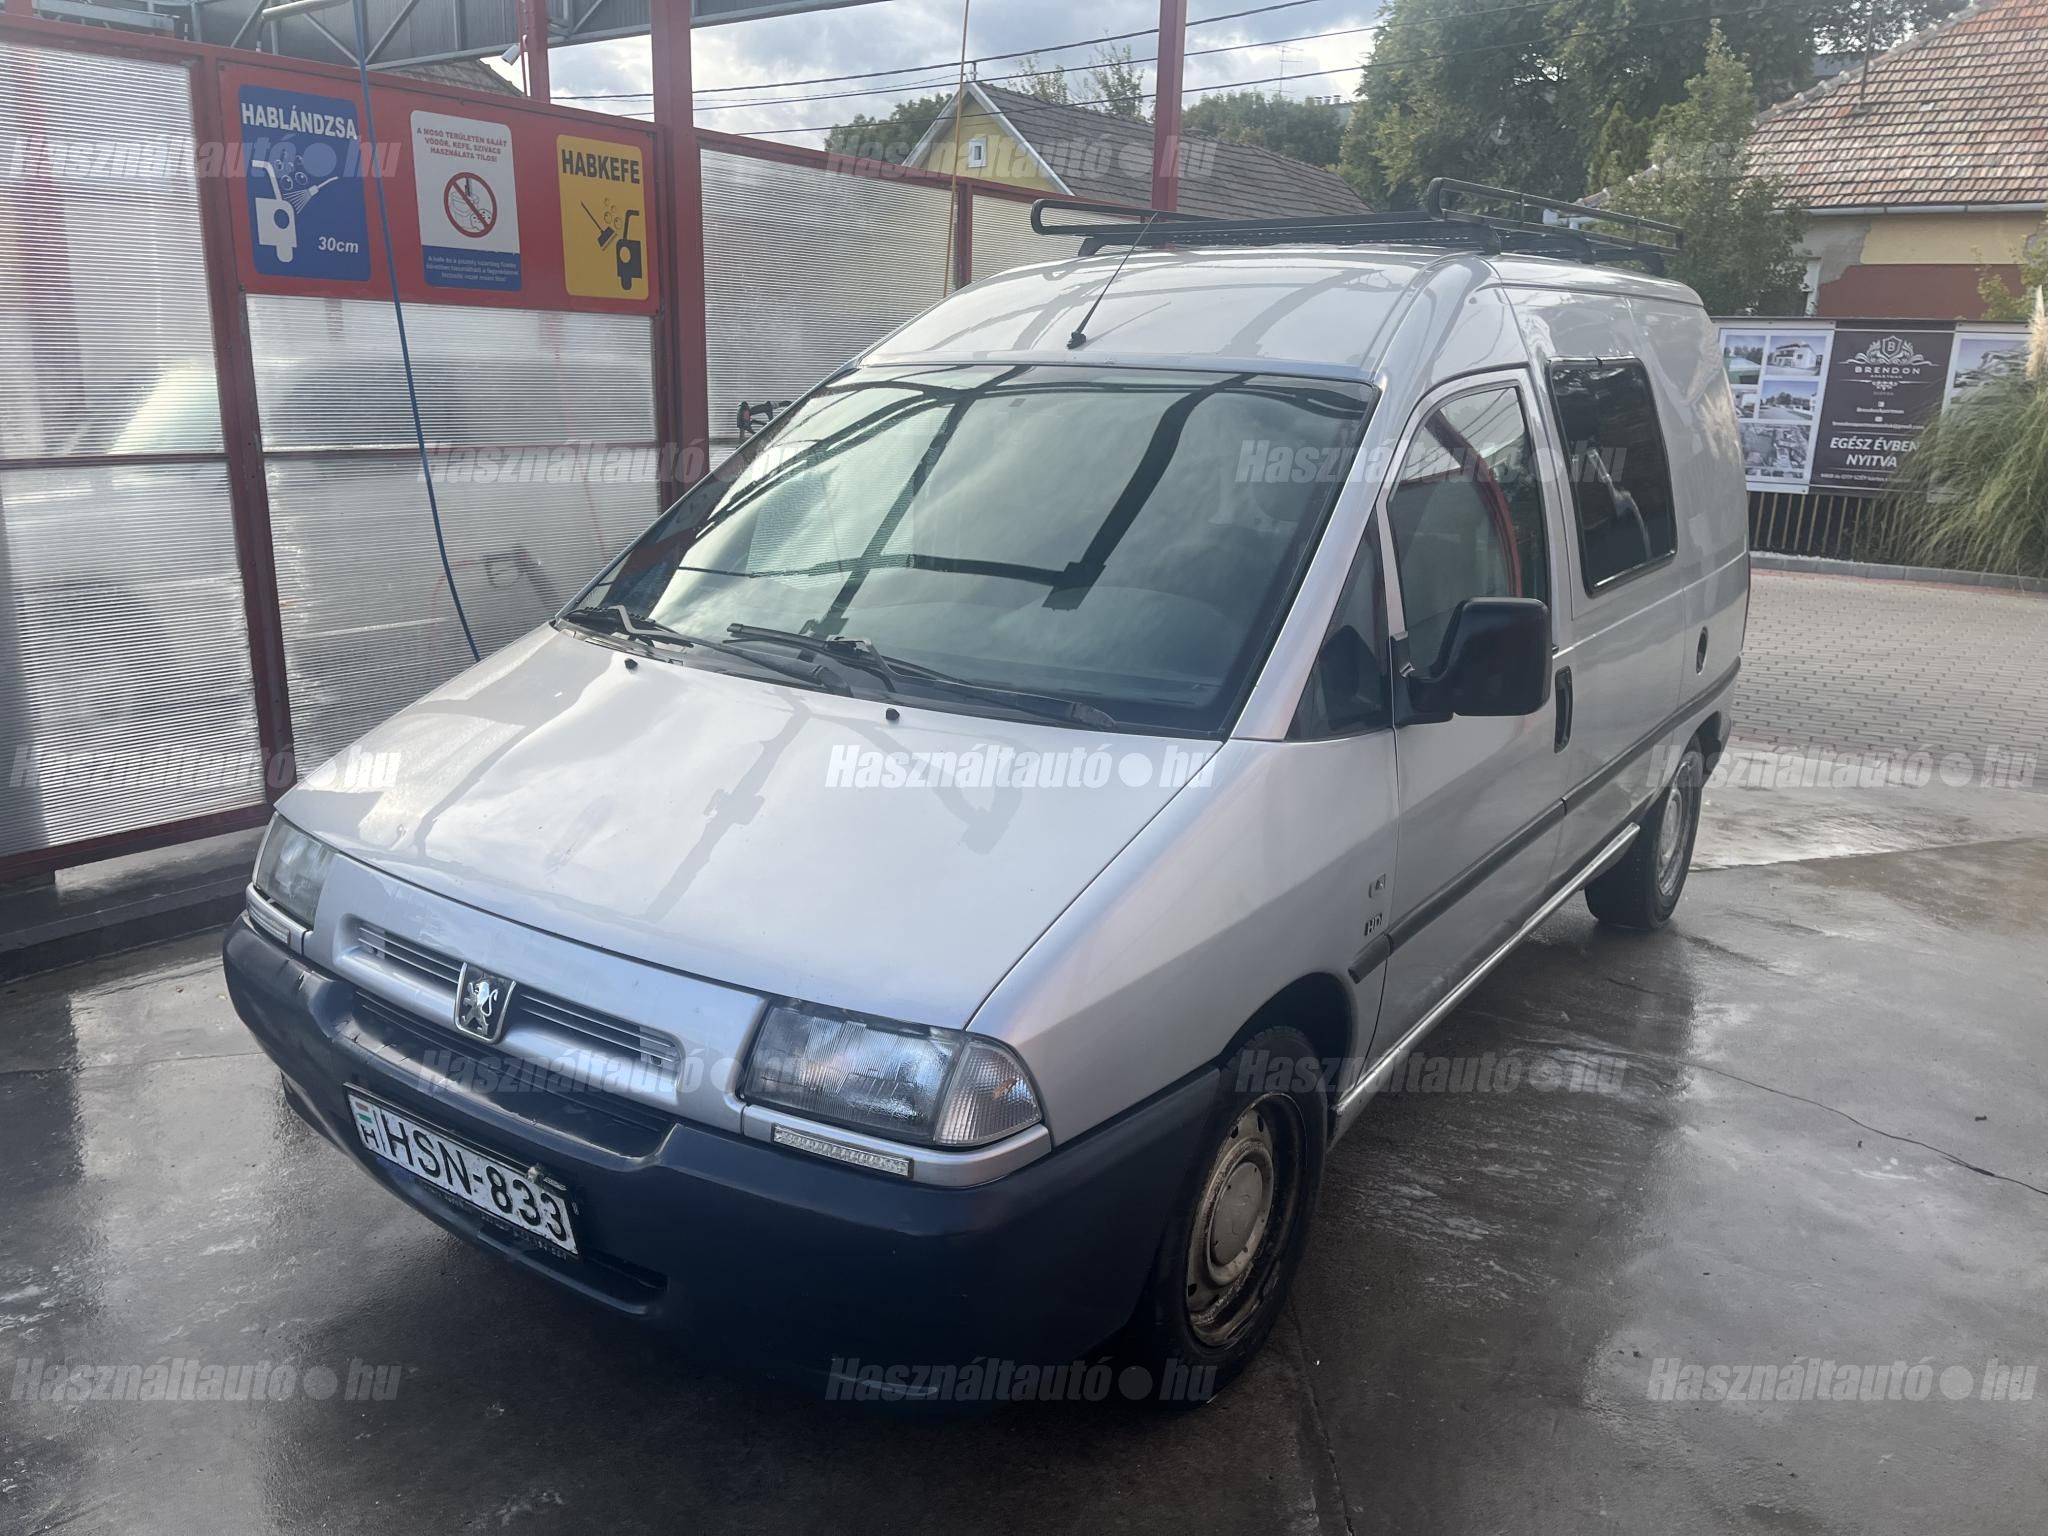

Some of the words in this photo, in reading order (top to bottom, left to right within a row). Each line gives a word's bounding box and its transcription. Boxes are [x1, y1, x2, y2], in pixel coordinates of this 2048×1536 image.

[240, 102, 358, 141] HABLÁNDZSA
[416, 127, 422, 135] A
[561, 148, 641, 185] HABKEFE
[318, 236, 359, 253] 30cm
[1854, 365, 1921, 375] BRENDON
[1829, 435, 1873, 450] EGÉSZ
[1873, 436, 1920, 452] ÉVBEN
[1845, 453, 1898, 468] NYITVA
[361, 1125, 380, 1149] H
[381, 1113, 567, 1242] HSN-833
